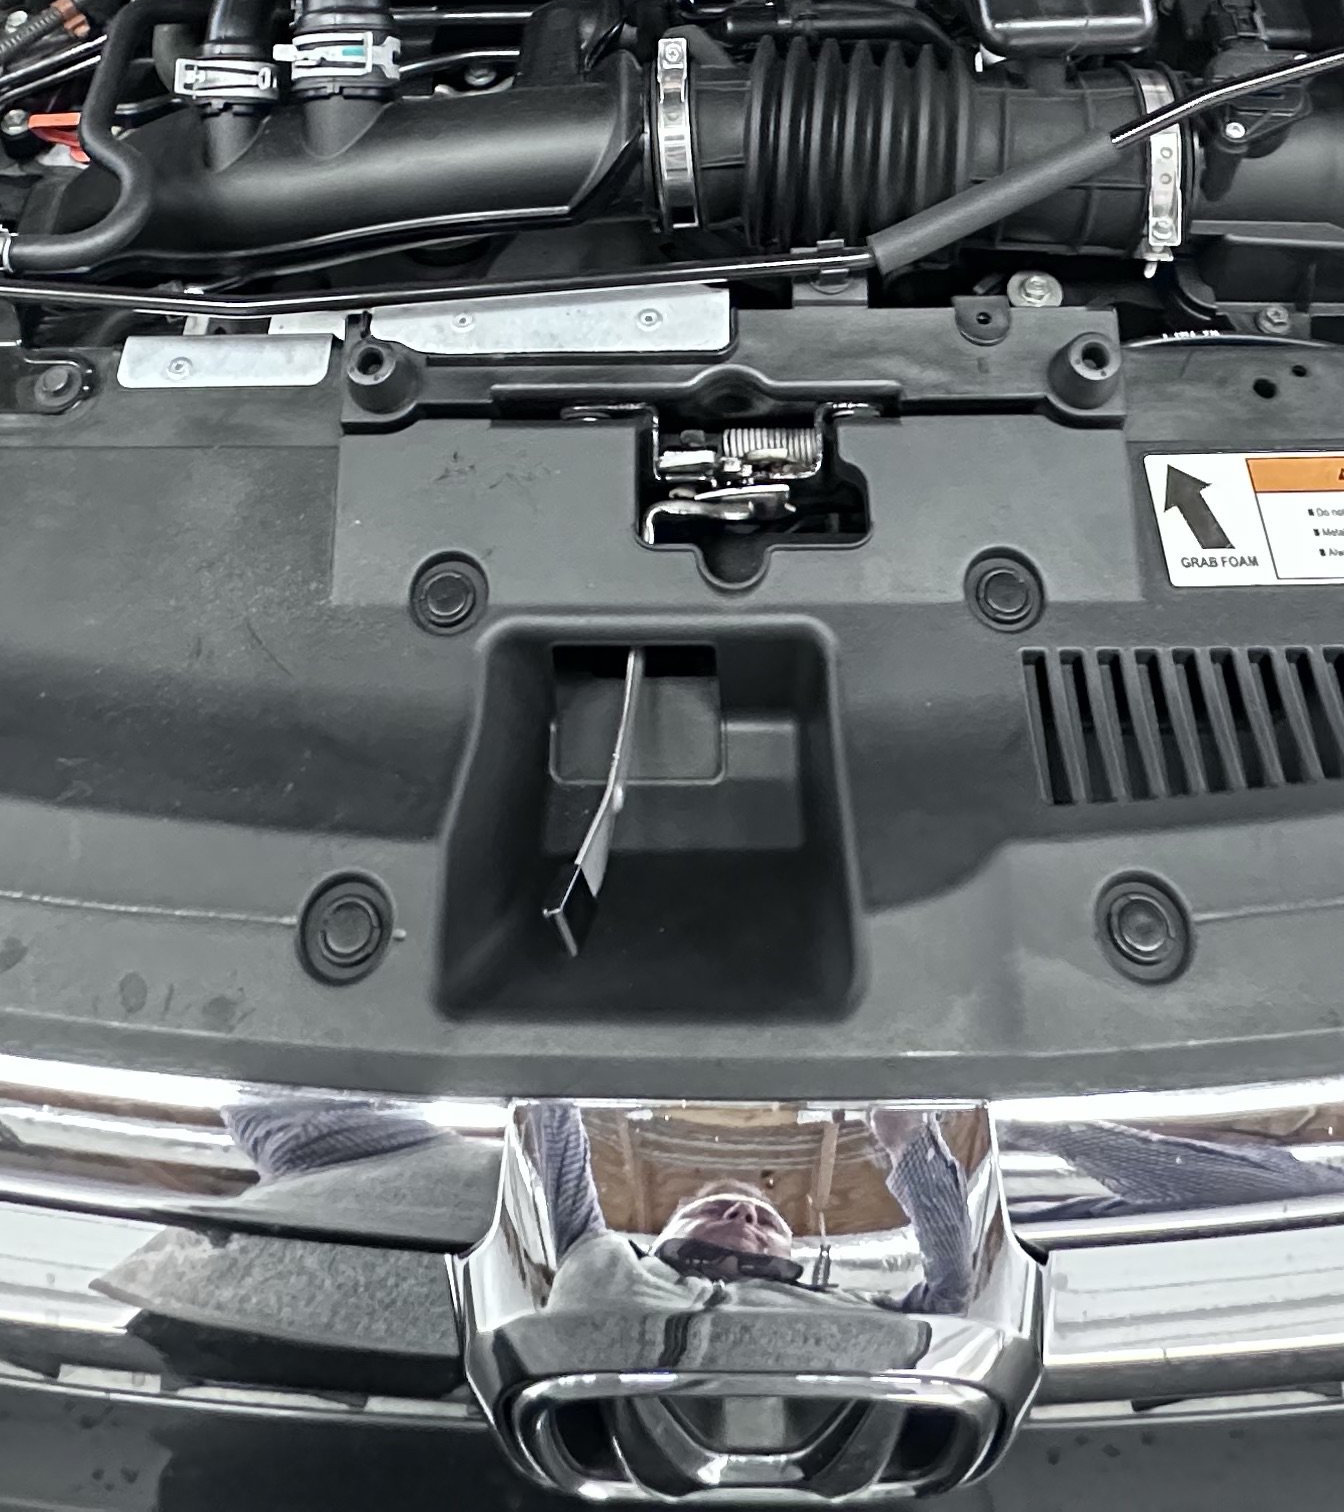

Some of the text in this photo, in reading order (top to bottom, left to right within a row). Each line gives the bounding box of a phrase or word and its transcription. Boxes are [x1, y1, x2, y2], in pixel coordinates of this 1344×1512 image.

[1316, 507, 1330, 517] Do
[1180, 555, 1259, 568] GRAB FOAM
